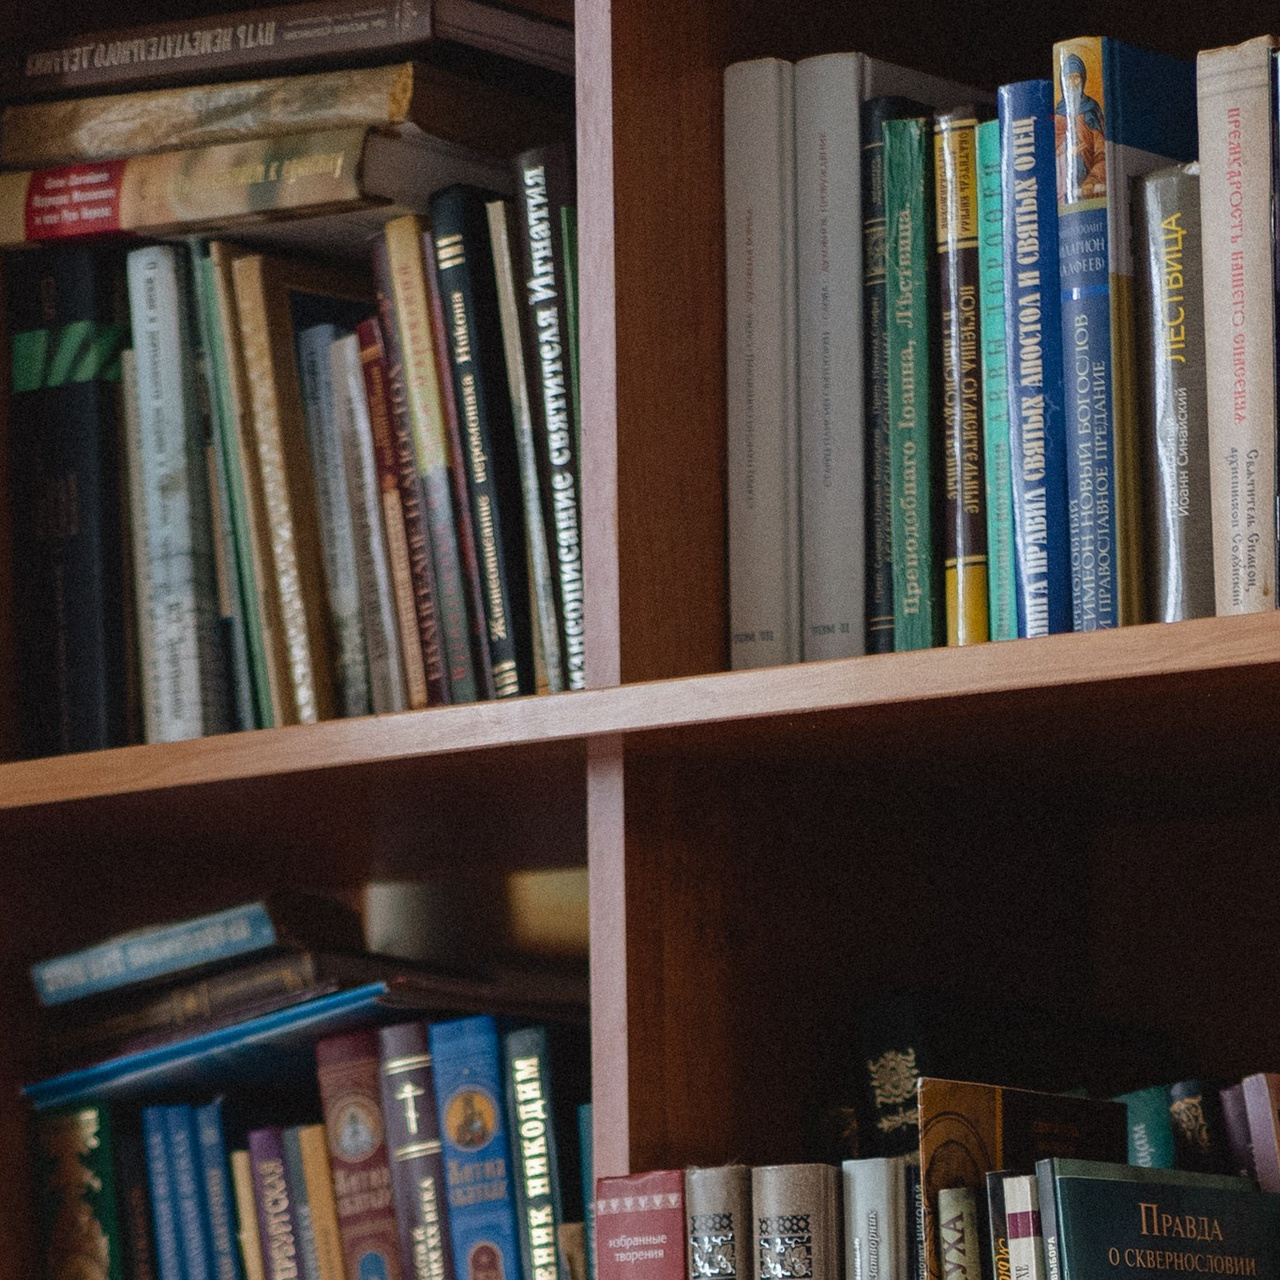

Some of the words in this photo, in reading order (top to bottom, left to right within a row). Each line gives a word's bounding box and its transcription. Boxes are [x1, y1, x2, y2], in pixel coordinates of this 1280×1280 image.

[1011, 114, 1037, 172] ОТЕЦ
[524, 166, 556, 303] Игнатия
[1014, 179, 1039, 264] СВЯТЫХ
[1017, 270, 1040, 286] И
[1158, 213, 1186, 363] ЛЕСТВИЦА
[1229, 250, 1247, 327] НАШЕГО
[1018, 292, 1042, 388] АПОСТОЛ
[1071, 314, 1090, 435] БОГОСЛОВ
[538, 308, 573, 466] святителя
[1089, 360, 1107, 460] ПРЕДАНИЕ
[1020, 396, 1044, 480] СВЯТЫХ
[1074, 440, 1094, 526] НОВЫЙ
[1024, 487, 1046, 576] ПРАВИЛ
[1092, 465, 1111, 613] ПРАВОСЛАВНОЕ
[513, 1056, 550, 1197] НИКОДИМ
[608, 1233, 668, 1250] избранные
[613, 1247, 665, 1262] творения
[1046, 1235, 1060, 1280] ВЫБОРА
[1108, 1247, 1120, 1266] О
[1124, 1248, 1257, 1277] СКВЕРНОСЛОВИИ
